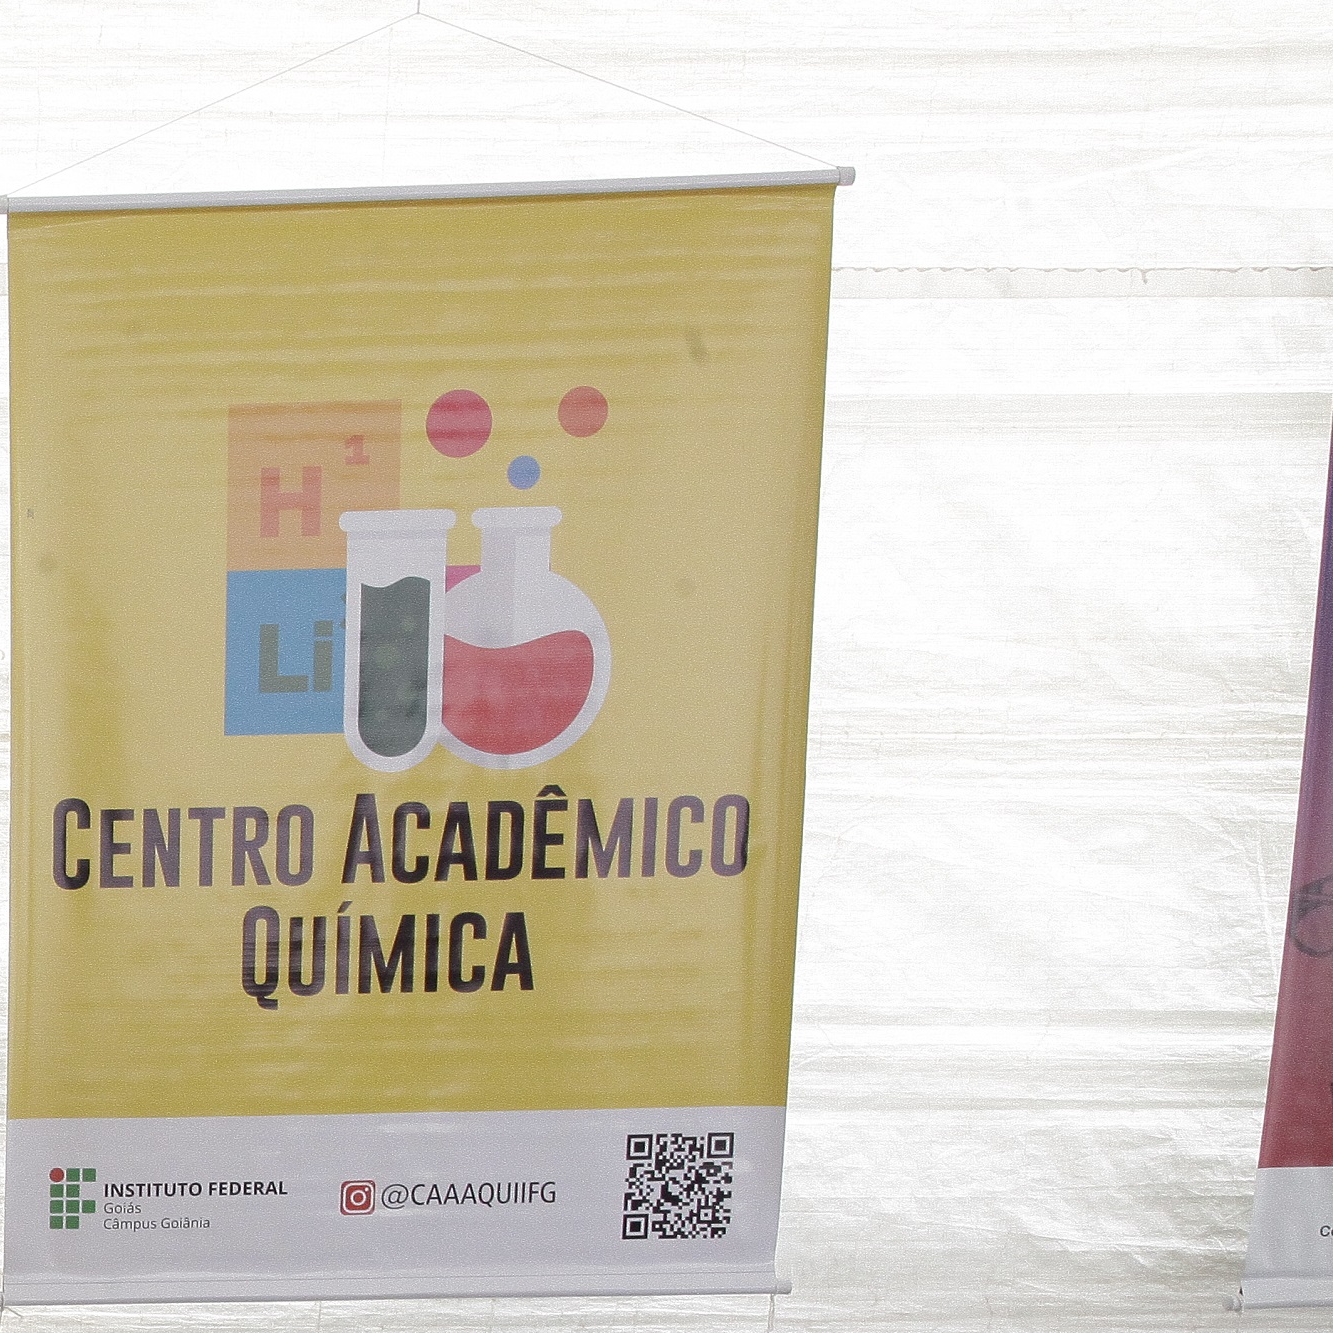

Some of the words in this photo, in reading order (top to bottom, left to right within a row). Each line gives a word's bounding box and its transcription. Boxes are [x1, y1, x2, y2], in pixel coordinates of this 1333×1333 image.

[344, 434, 370, 465] 1
[260, 466, 322, 538] H
[259, 620, 333, 693] Li
[52, 797, 315, 891] CENTRO
[341, 783, 753, 886] ACADÊMICO
[241, 900, 535, 1011] QUÍMICA
[103, 1182, 202, 1198] INSTITUTO
[209, 1181, 288, 1196] FEDERAL
[103, 1202, 141, 1214] Goiás
[103, 1217, 157, 1232] Câmpus
[161, 1216, 210, 1229] Goiânia
